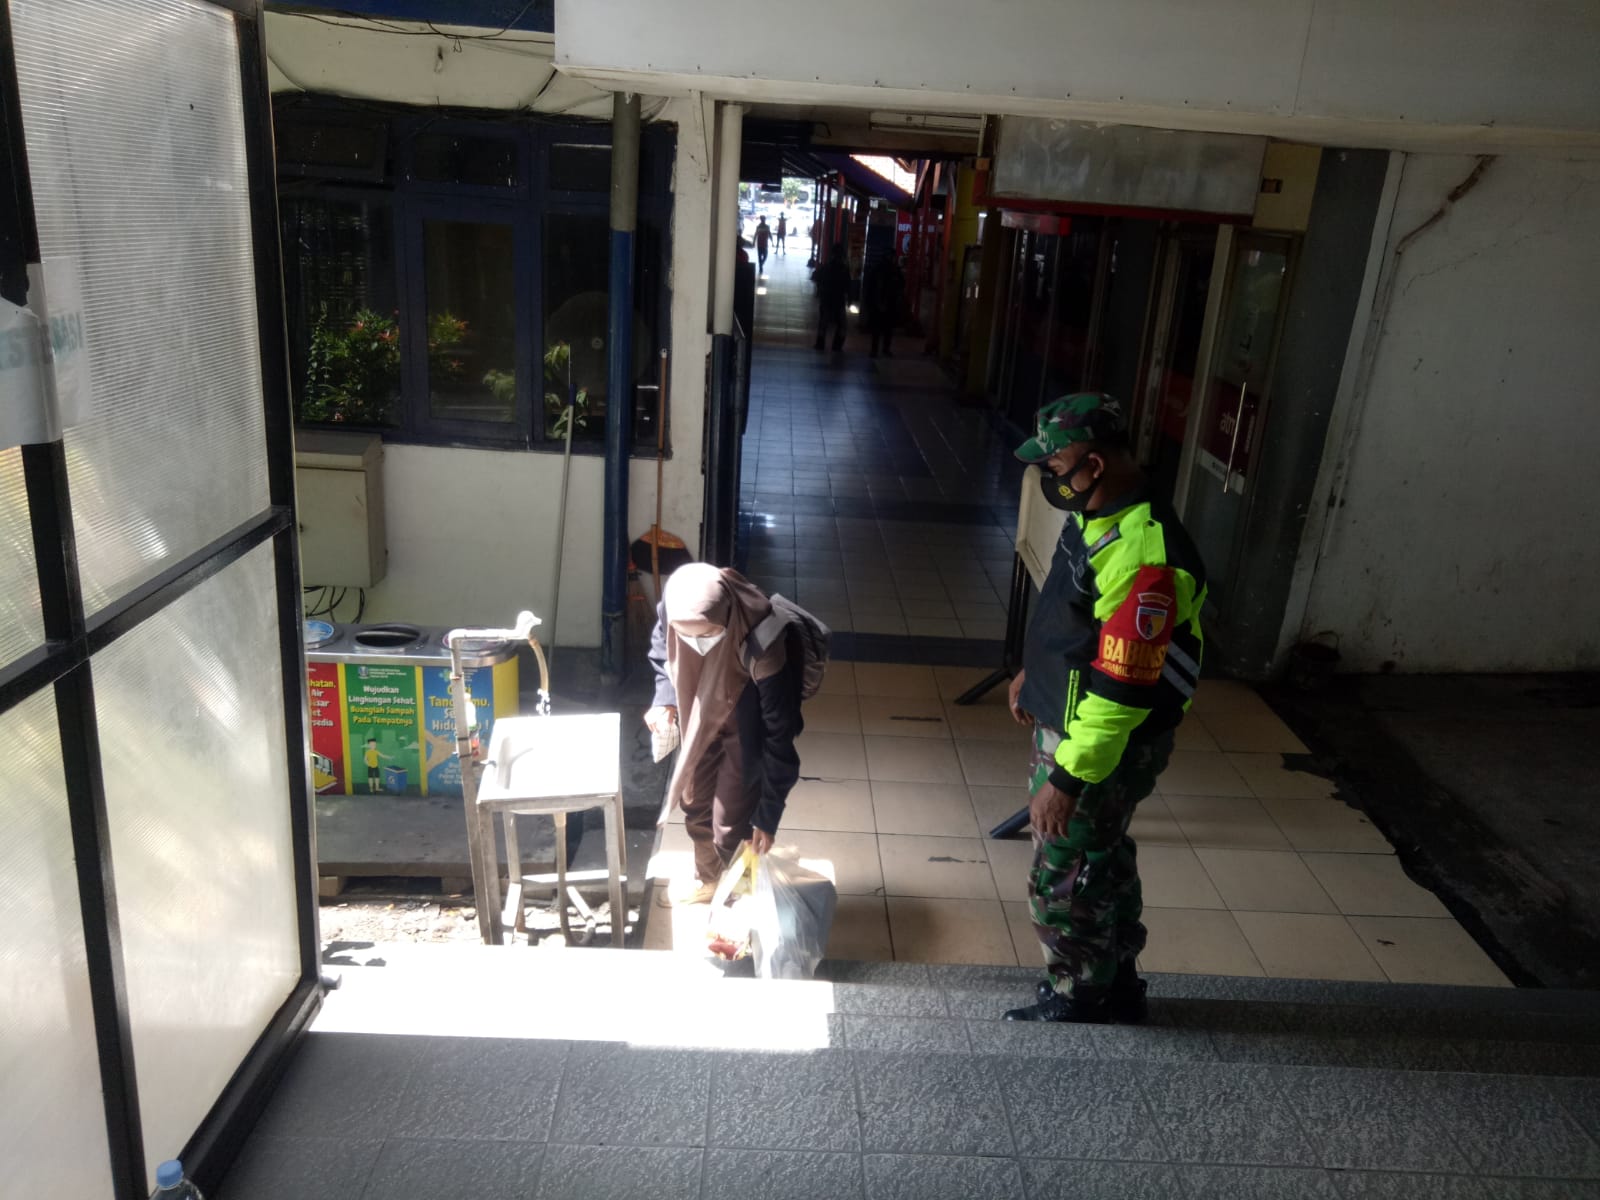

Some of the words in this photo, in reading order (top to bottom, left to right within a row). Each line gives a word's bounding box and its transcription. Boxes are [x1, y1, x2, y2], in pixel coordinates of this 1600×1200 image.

[1103, 634, 1168, 668] BABINS
[363, 685, 399, 695] Wujudkan
[348, 696, 391, 706] Lingkungan
[351, 706, 384, 715] Buanglah
[387, 707, 414, 716] Sampah
[353, 716, 371, 724] Pada
[373, 717, 413, 727] Tempatnya
